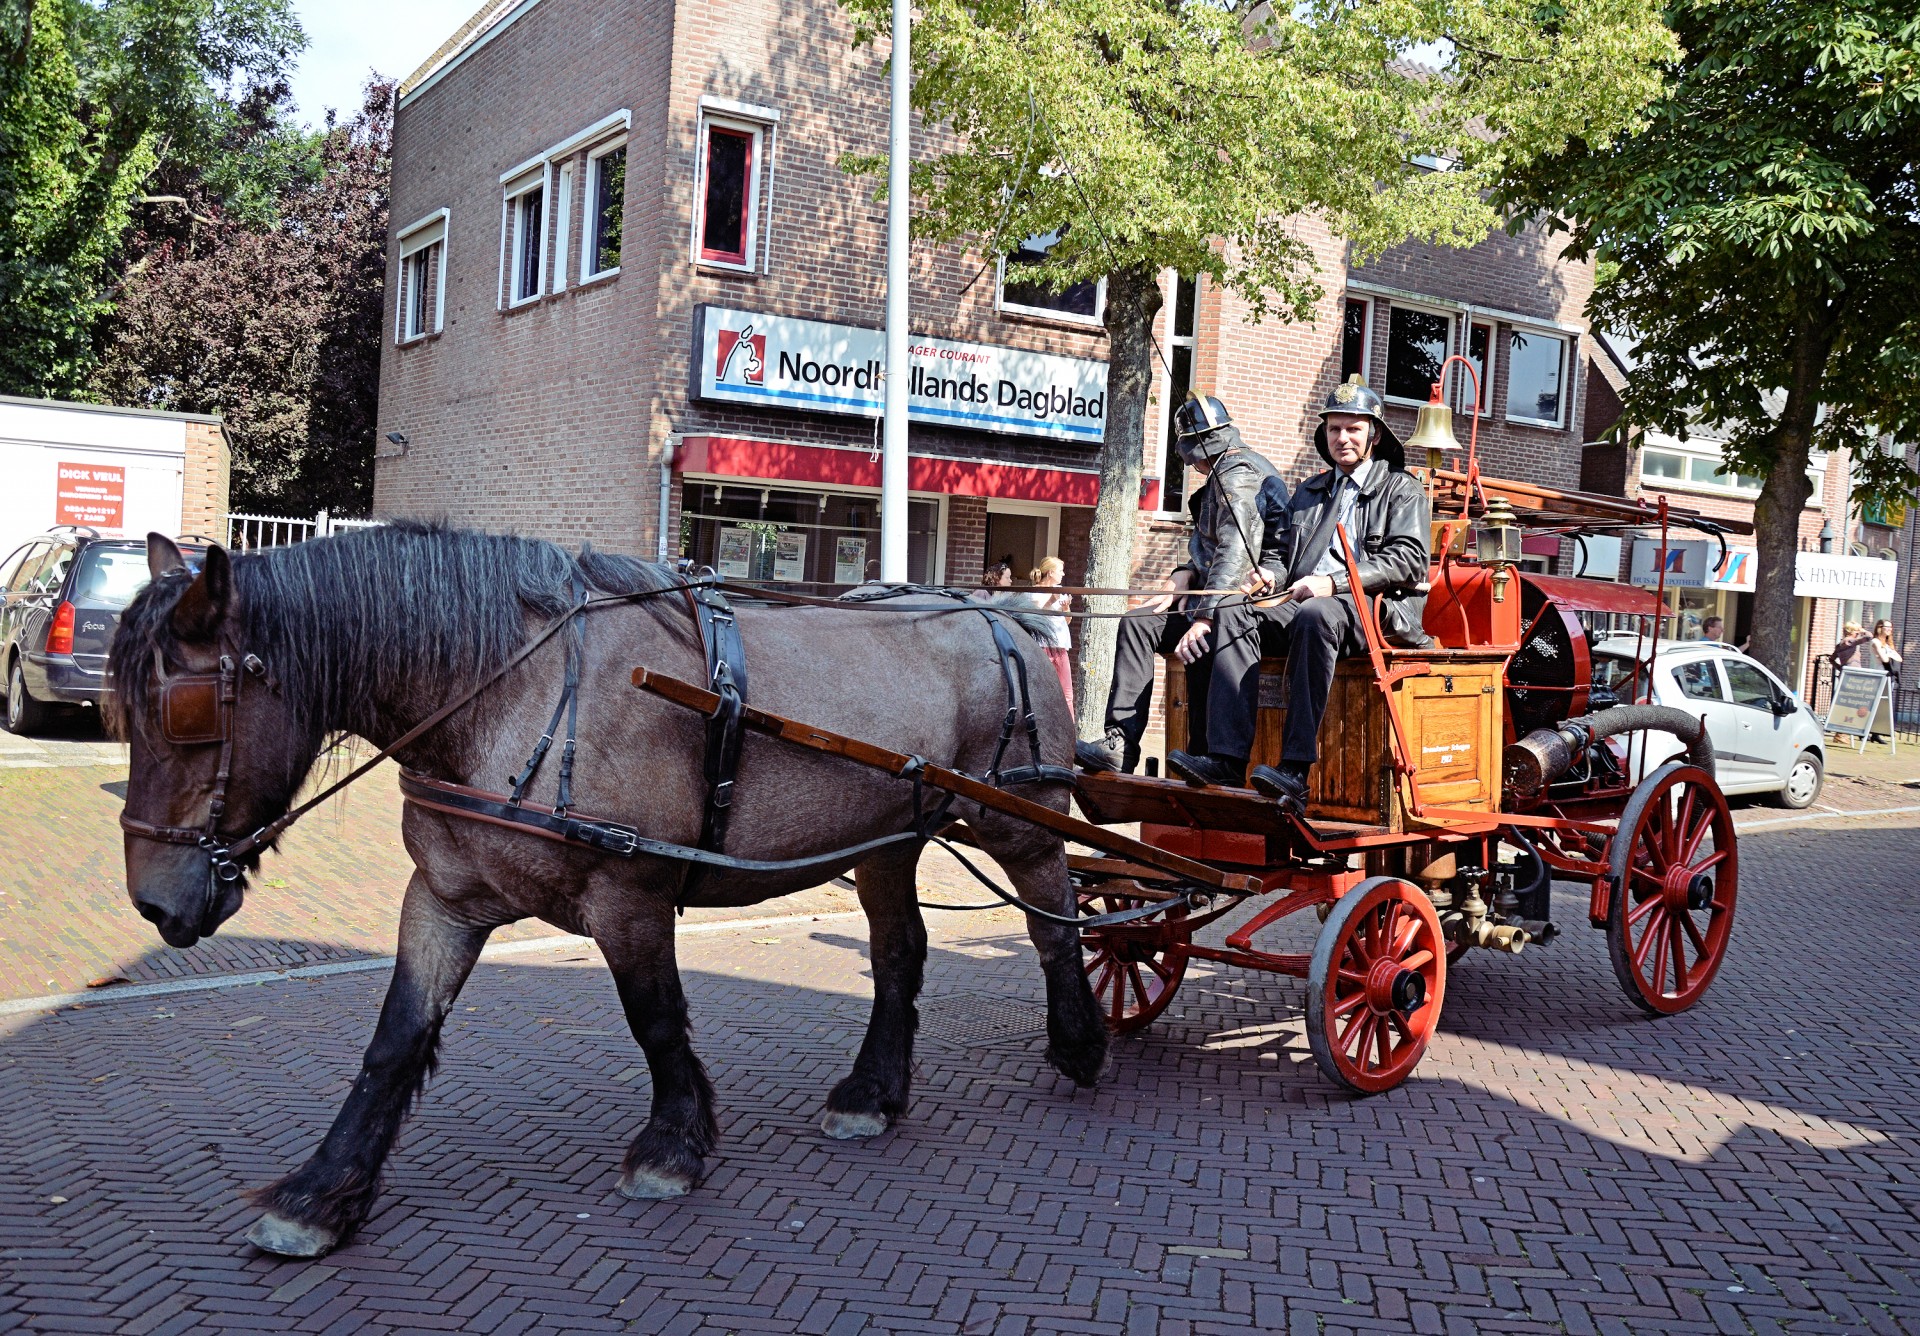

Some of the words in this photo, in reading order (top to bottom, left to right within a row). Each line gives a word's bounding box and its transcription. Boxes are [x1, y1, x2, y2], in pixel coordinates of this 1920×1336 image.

[908, 345, 936, 357] AGER
[939, 350, 991, 365] COURANT
[997, 379, 1104, 419] Dagblad
[60, 468, 90, 480] DICK
[92, 471, 123, 483] VEUL
[84, 514, 106, 522] ZAND
[1633, 576, 1650, 584] HUIS
[1665, 578, 1702, 587] YPOTHEEK
[1810, 567, 1887, 588] HYPOTHEEK
